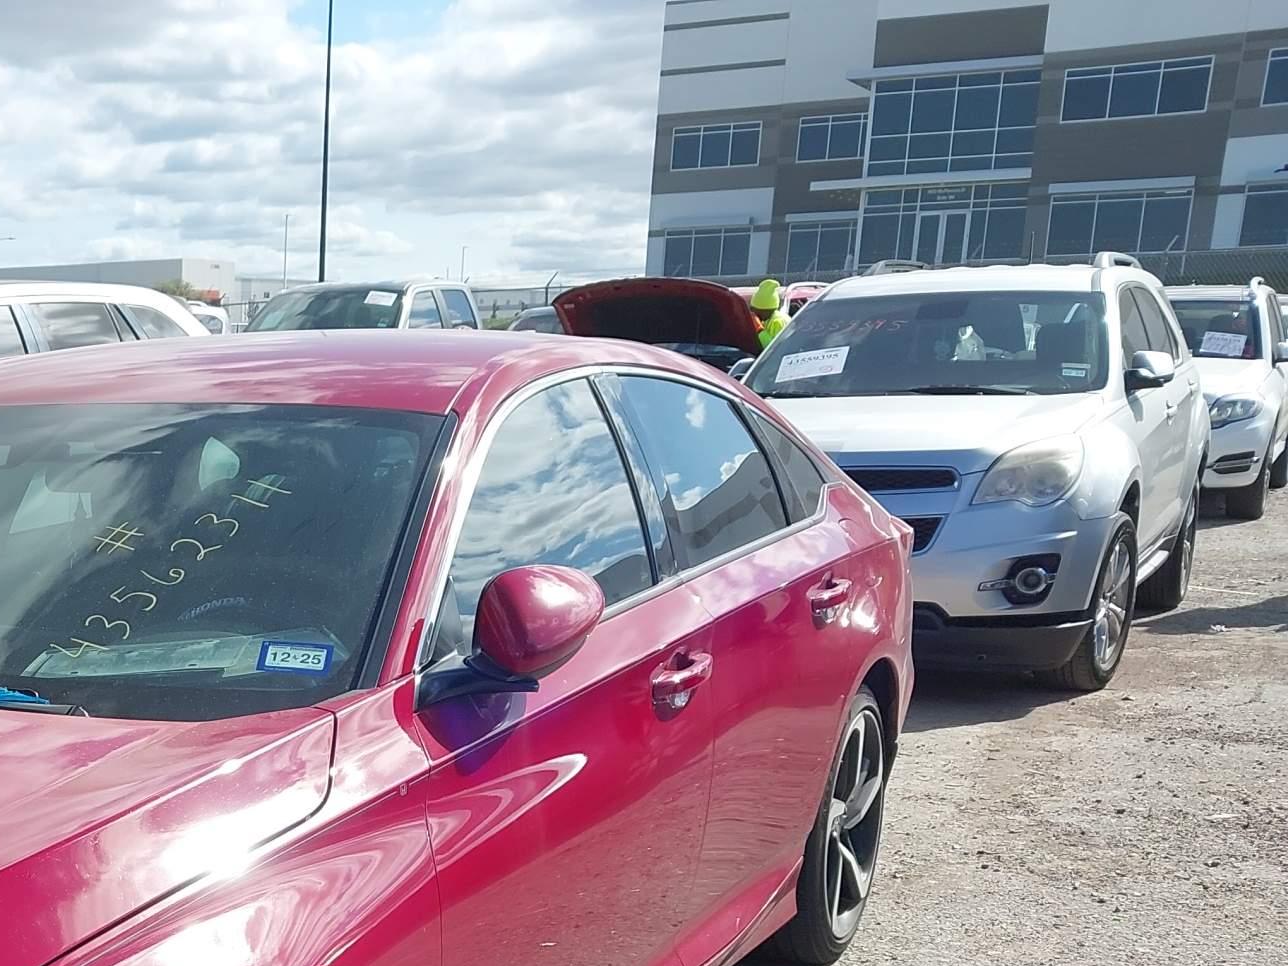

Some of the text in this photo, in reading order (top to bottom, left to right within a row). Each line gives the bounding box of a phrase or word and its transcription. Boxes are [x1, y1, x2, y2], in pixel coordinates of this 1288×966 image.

[93, 522, 145, 554] #
[270, 651, 323, 665] 12 25
